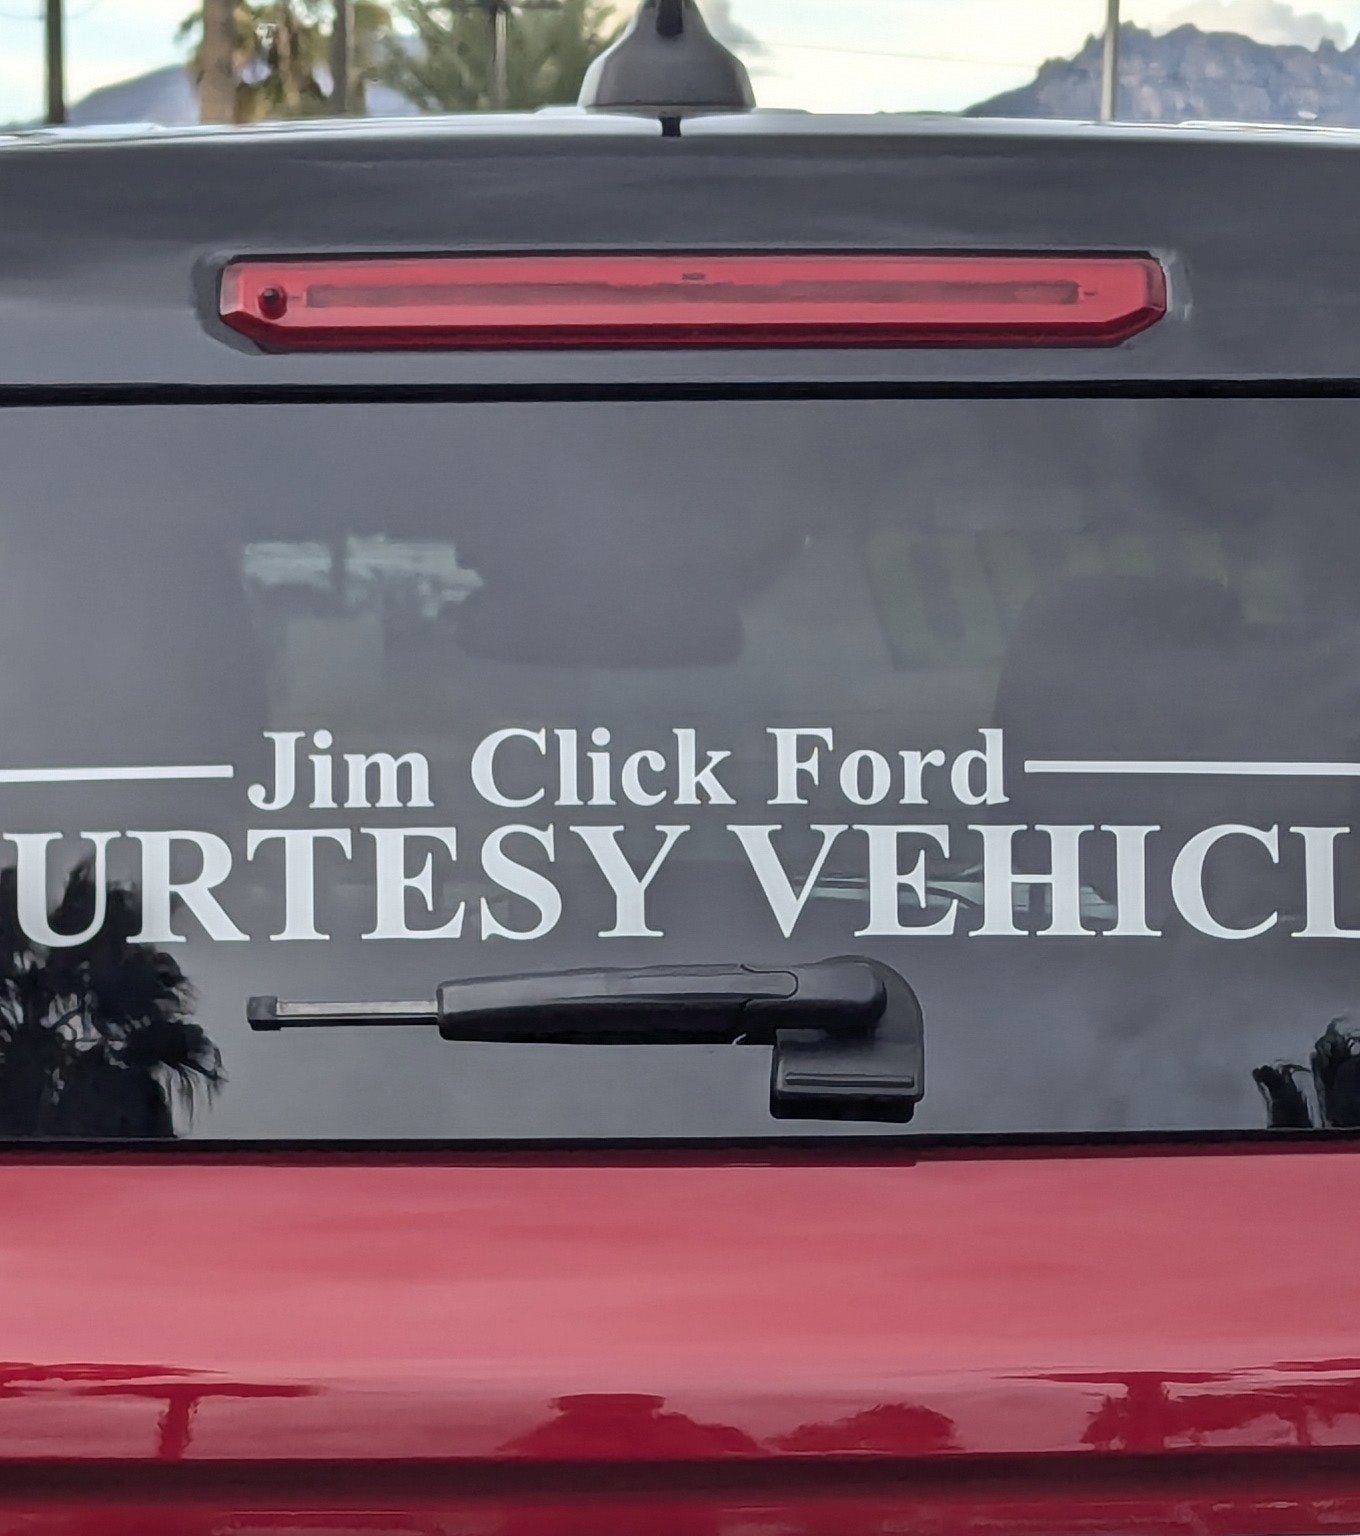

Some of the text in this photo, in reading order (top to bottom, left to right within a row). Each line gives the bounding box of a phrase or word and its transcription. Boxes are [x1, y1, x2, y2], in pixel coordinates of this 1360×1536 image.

[247, 726, 1011, 811] Jim Click Ford
